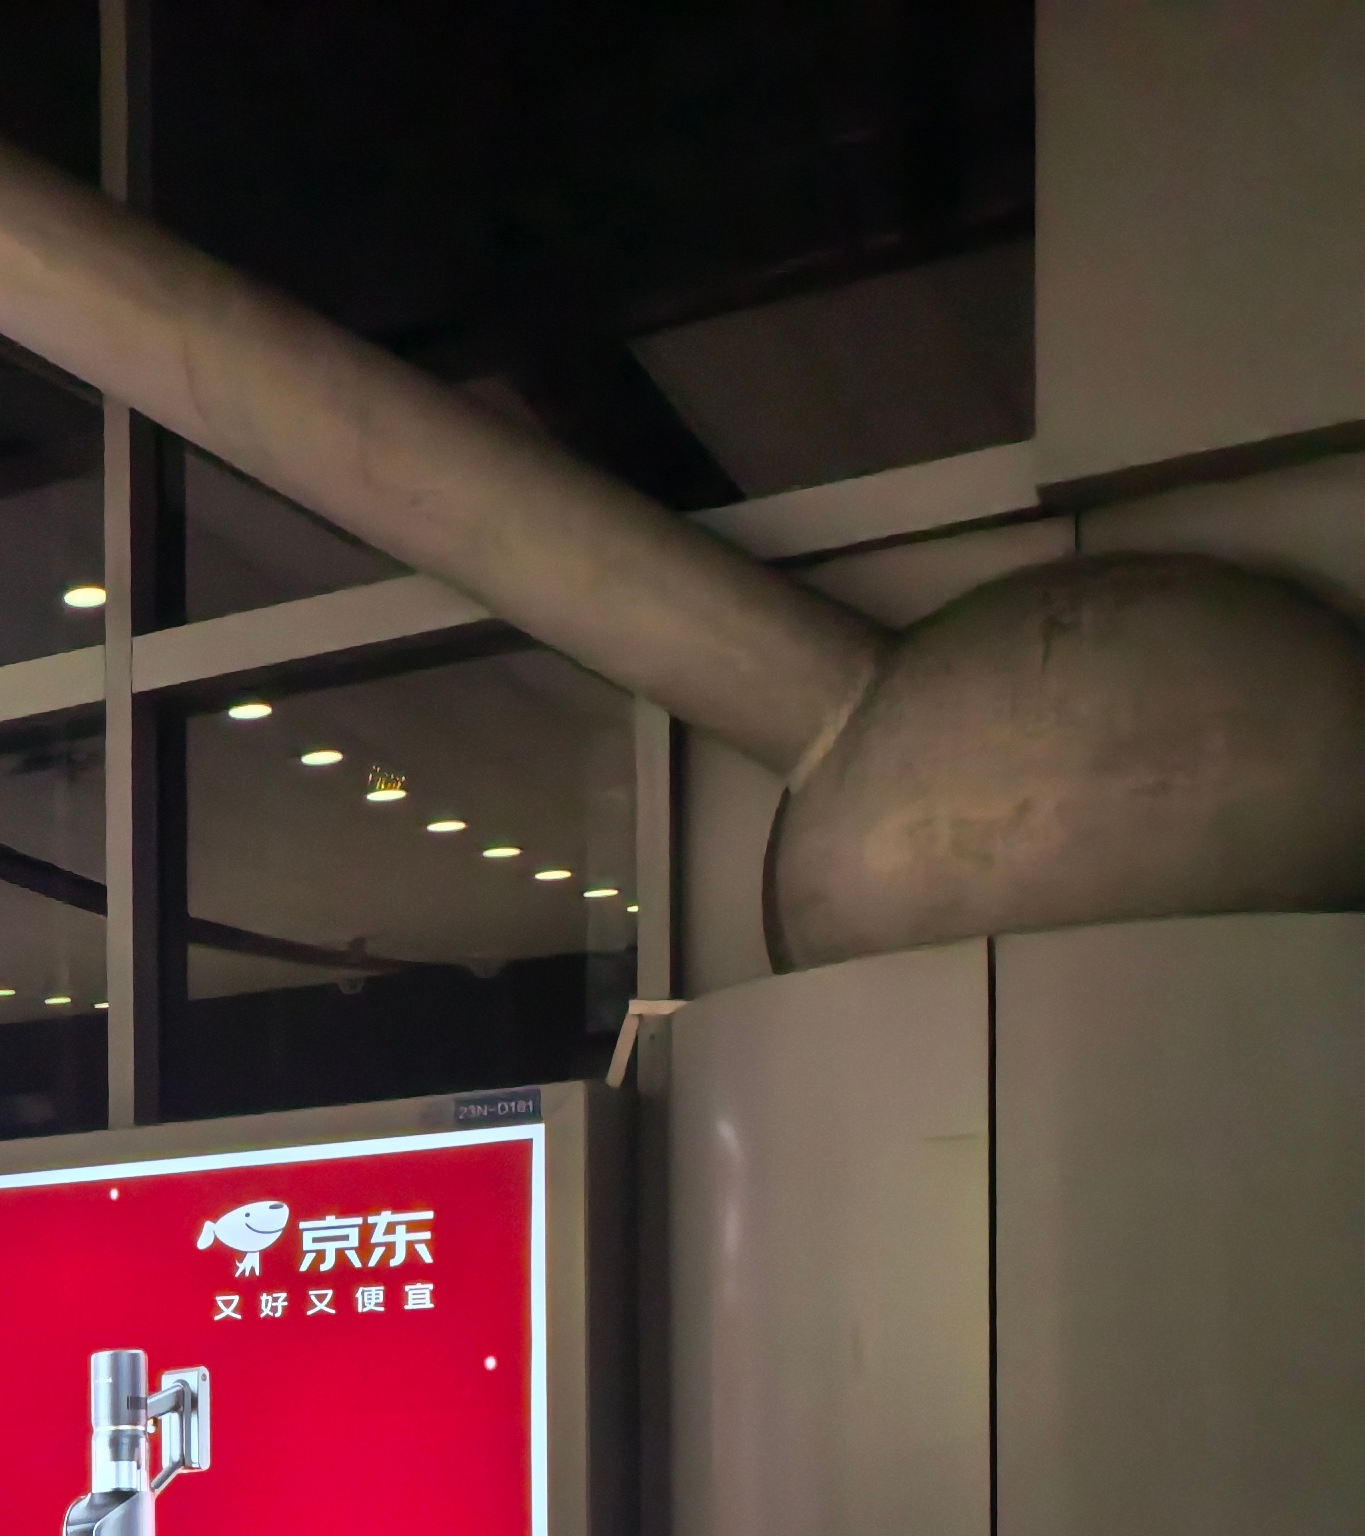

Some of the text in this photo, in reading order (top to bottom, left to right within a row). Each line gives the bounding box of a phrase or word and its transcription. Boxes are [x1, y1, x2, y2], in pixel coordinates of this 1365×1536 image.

[299, 1211, 434, 1271] 京东
[214, 1283, 434, 1320] 又好又便宜
